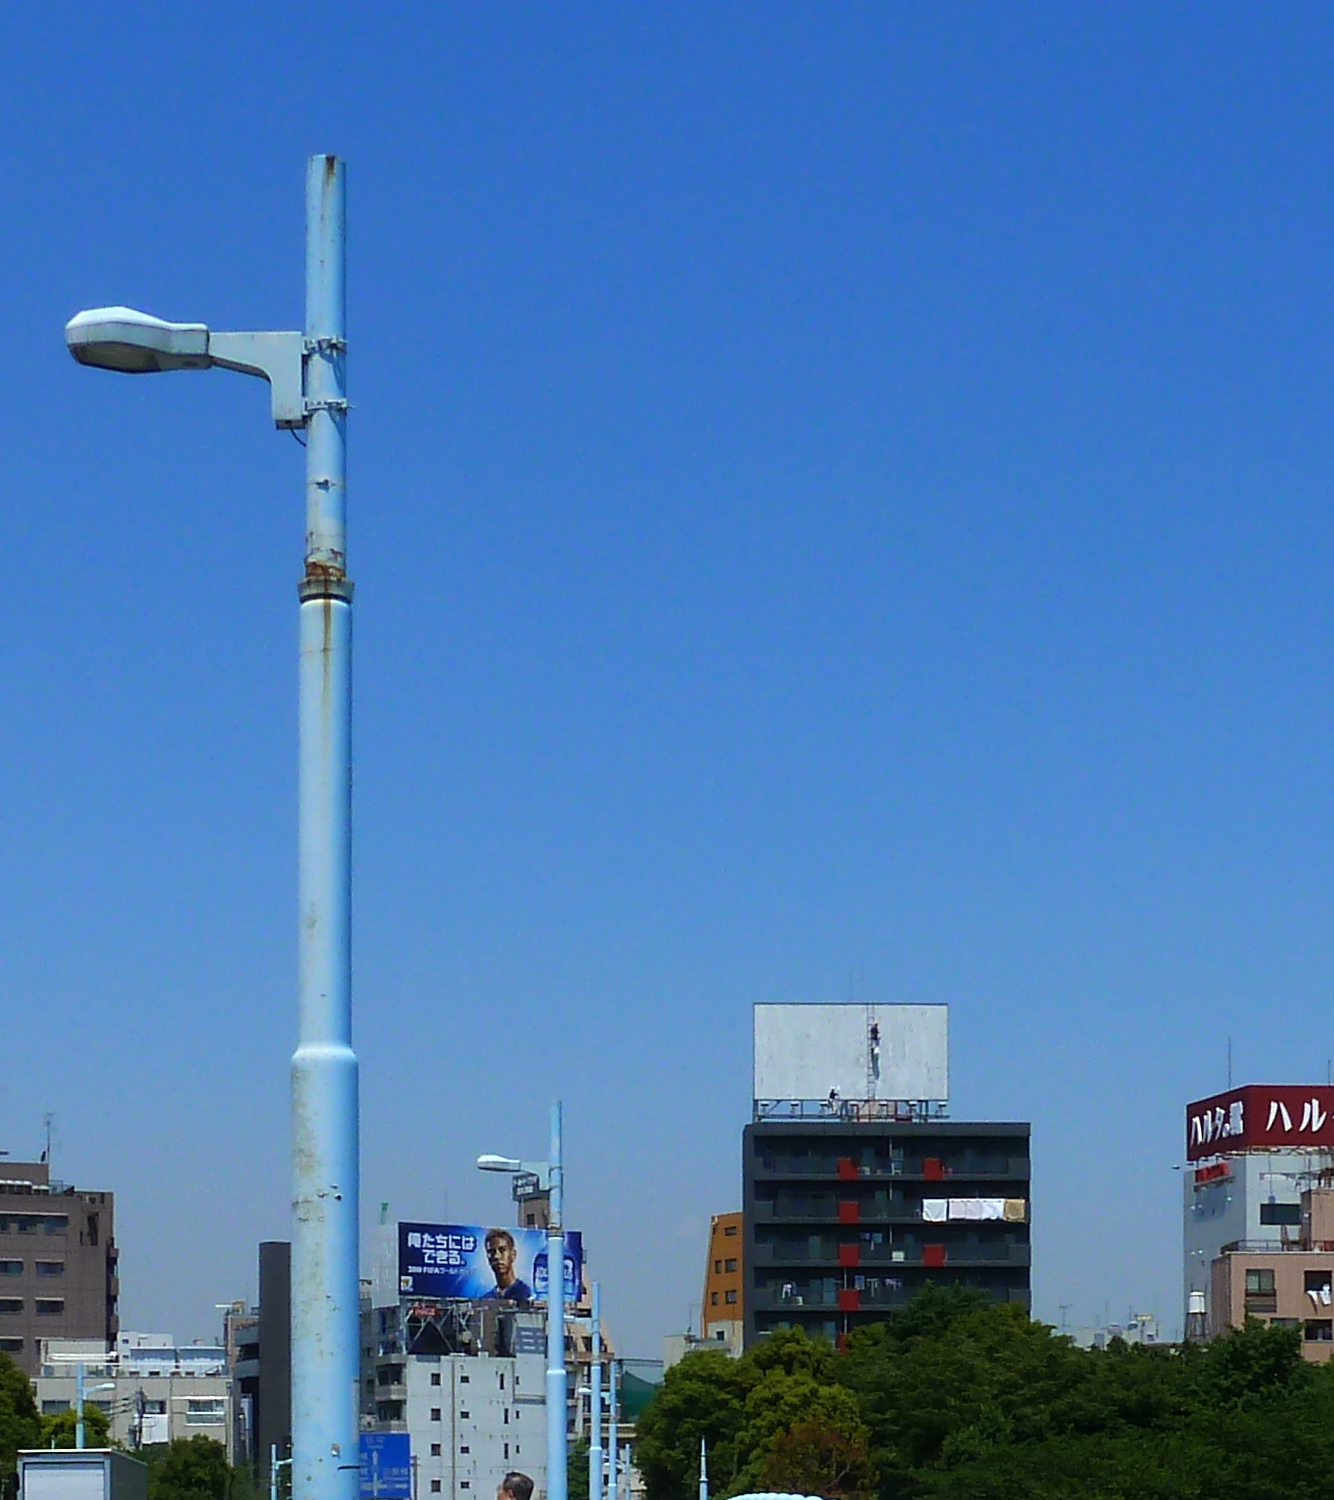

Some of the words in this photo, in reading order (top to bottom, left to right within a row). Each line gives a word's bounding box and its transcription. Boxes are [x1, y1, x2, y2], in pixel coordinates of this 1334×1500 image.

[407, 1232, 475, 1250] 俺たちには
[421, 1249, 466, 1266] できる。
